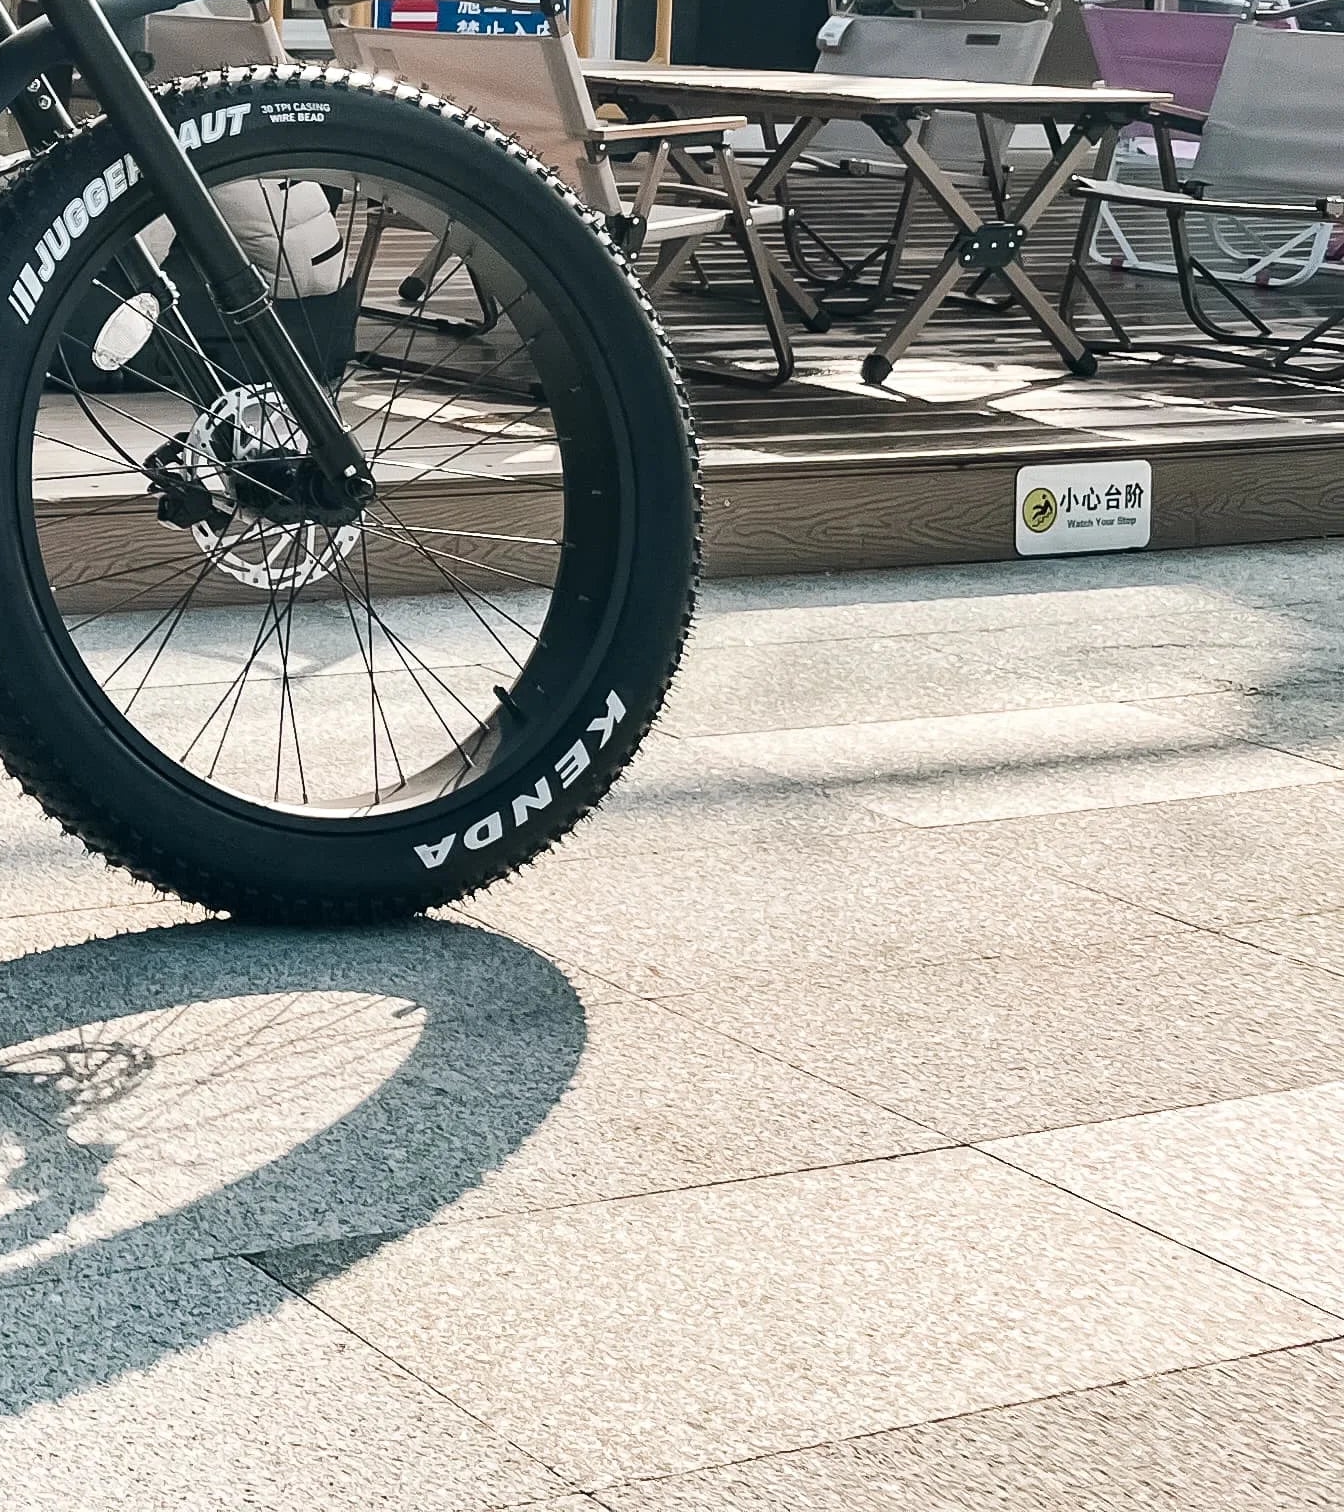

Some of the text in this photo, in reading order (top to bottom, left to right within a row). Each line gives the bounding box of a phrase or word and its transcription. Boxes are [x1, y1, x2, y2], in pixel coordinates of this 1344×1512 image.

[292, 102, 331, 113] CASING
[269, 112, 325, 123] WIRE BEAD
[1060, 482, 1145, 513] 小心台阶
[1066, 519, 1094, 529] Watch
[1095, 517, 1116, 527] Your
[413, 688, 627, 870] KENDA
